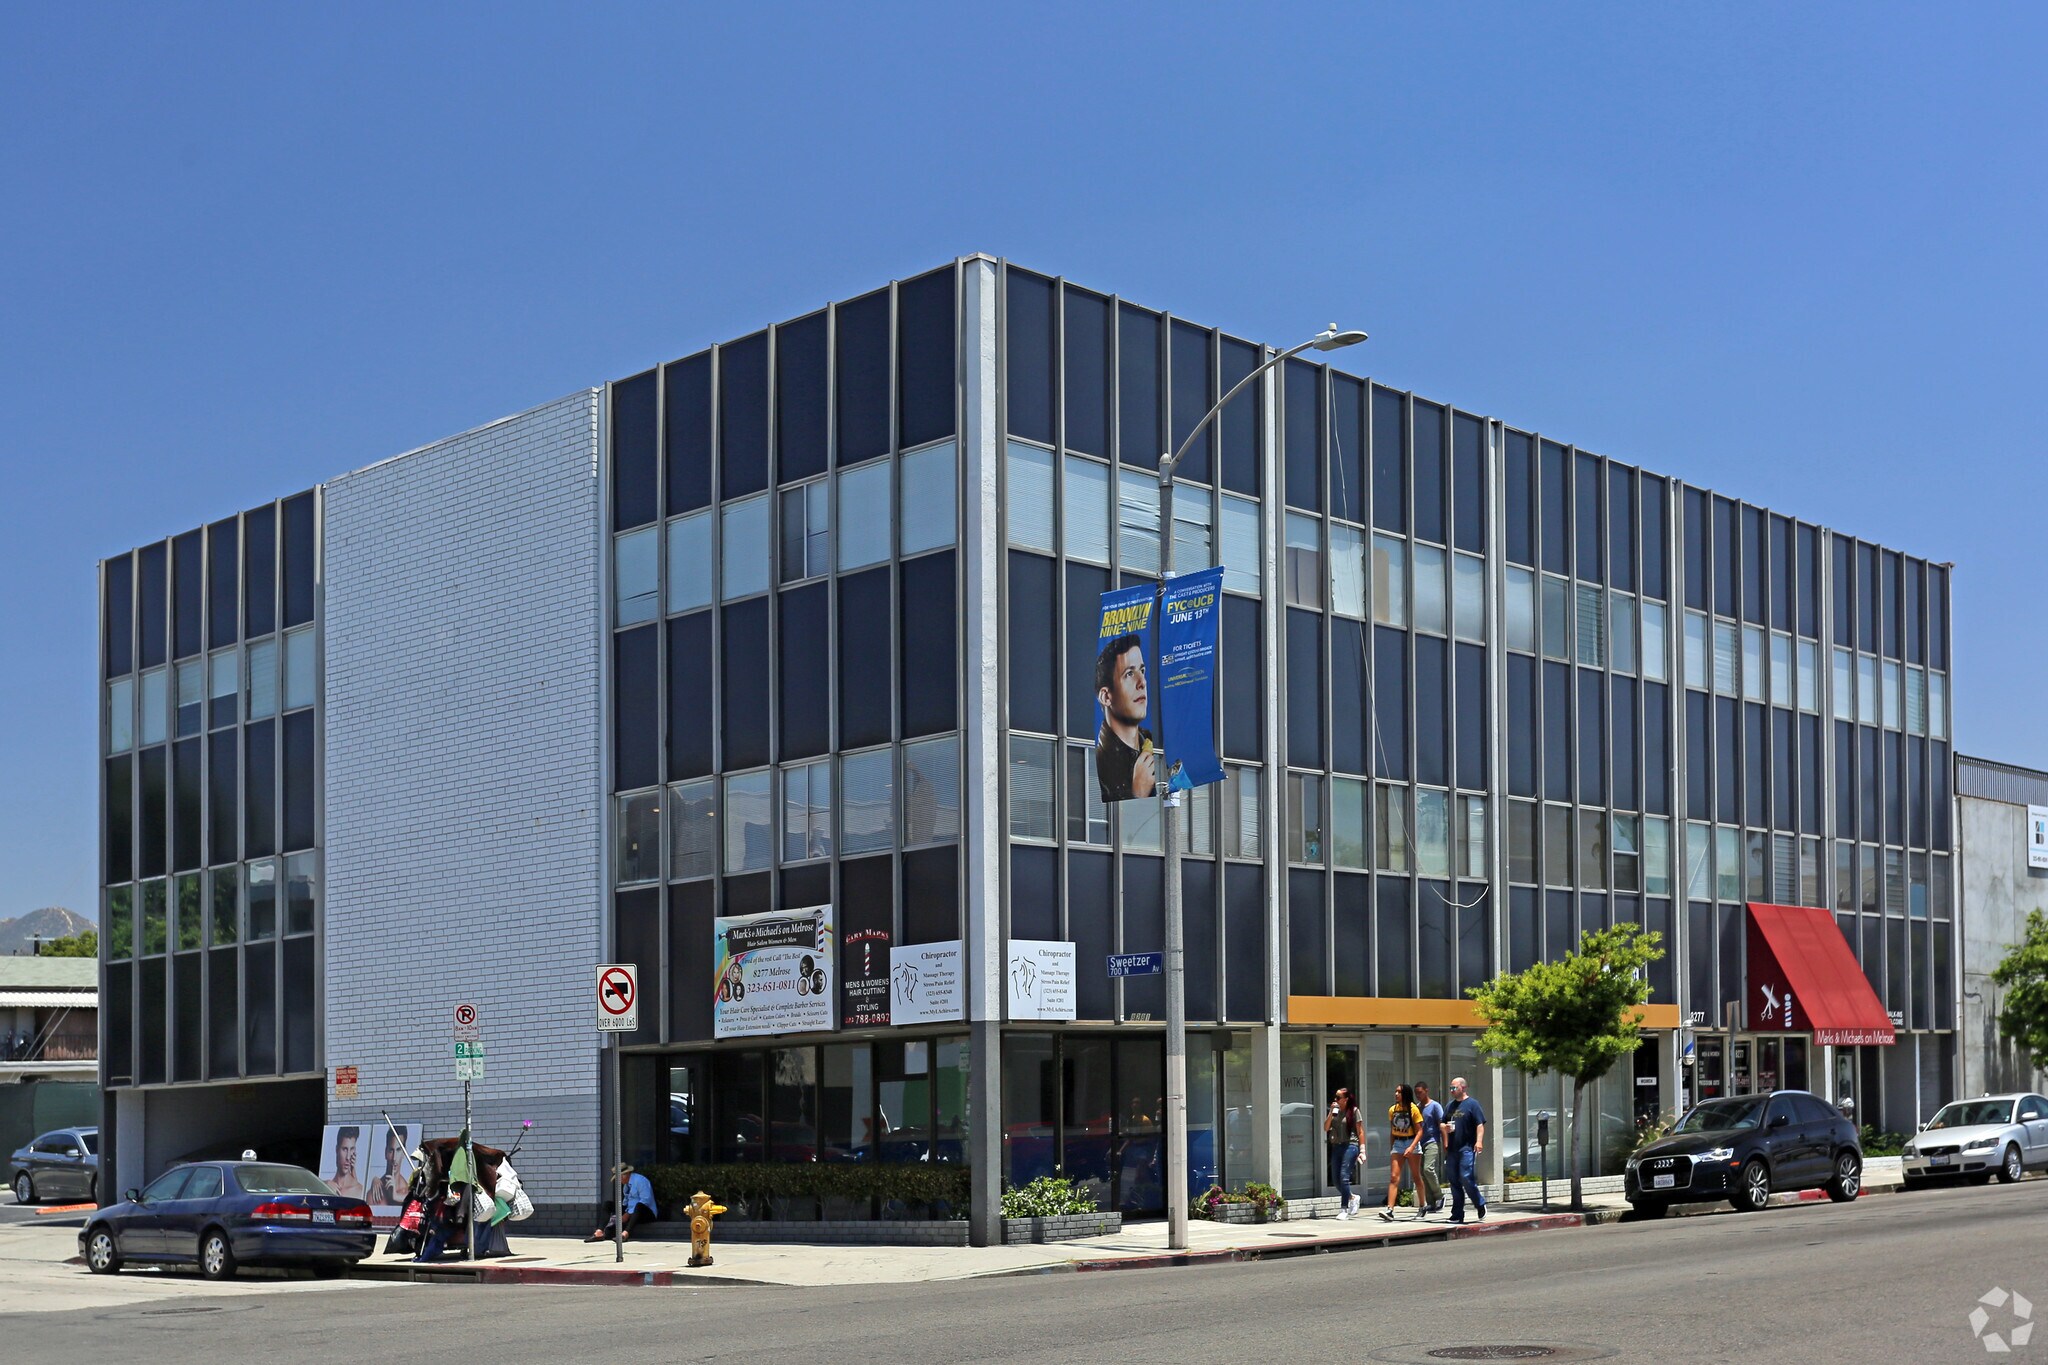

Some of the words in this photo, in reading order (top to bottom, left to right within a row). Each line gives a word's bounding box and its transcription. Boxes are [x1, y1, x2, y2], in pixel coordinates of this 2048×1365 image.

[1102, 602, 1152, 628] BROOKLYN
[1170, 611, 1193, 624] JUNE
[1100, 618, 1148, 638] NINE-NINE
[1172, 644, 1182, 652] FOR
[1184, 640, 1202, 650] TICKETS
[732, 928, 751, 939] Mark's
[755, 925, 781, 937] Michael's
[791, 922, 814, 933] Melrose
[921, 951, 957, 960] Chiropractor
[1038, 949, 1072, 958] Chiropractor
[1110, 956, 1150, 968] Sweetzer
[753, 968, 768, 978] 8277
[769, 967, 790, 976] Melrose
[1110, 968, 1122, 976] 700
[747, 980, 795, 993] 323-651-0811
[845, 980, 860, 989] MENS
[866, 978, 889, 987] WOMENS
[862, 987, 886, 995] CUTTING
[750, 1005, 770, 1014] Specialist
[776, 1002, 794, 1011] Complete
[856, 1004, 879, 1012] STYLING
[599, 1018, 610, 1027] OVER
[627, 1017, 635, 1026] LBS
[1691, 1012, 1705, 1022] 8277
[1817, 1030, 1834, 1043] Marks
[1835, 1032, 1840, 1043] &
[1840, 1030, 1864, 1043] Michaels
[1865, 1034, 1872, 1043] on
[1873, 1031, 1894, 1043] Melrose
[1284, 1077, 1306, 1087] WITKE
